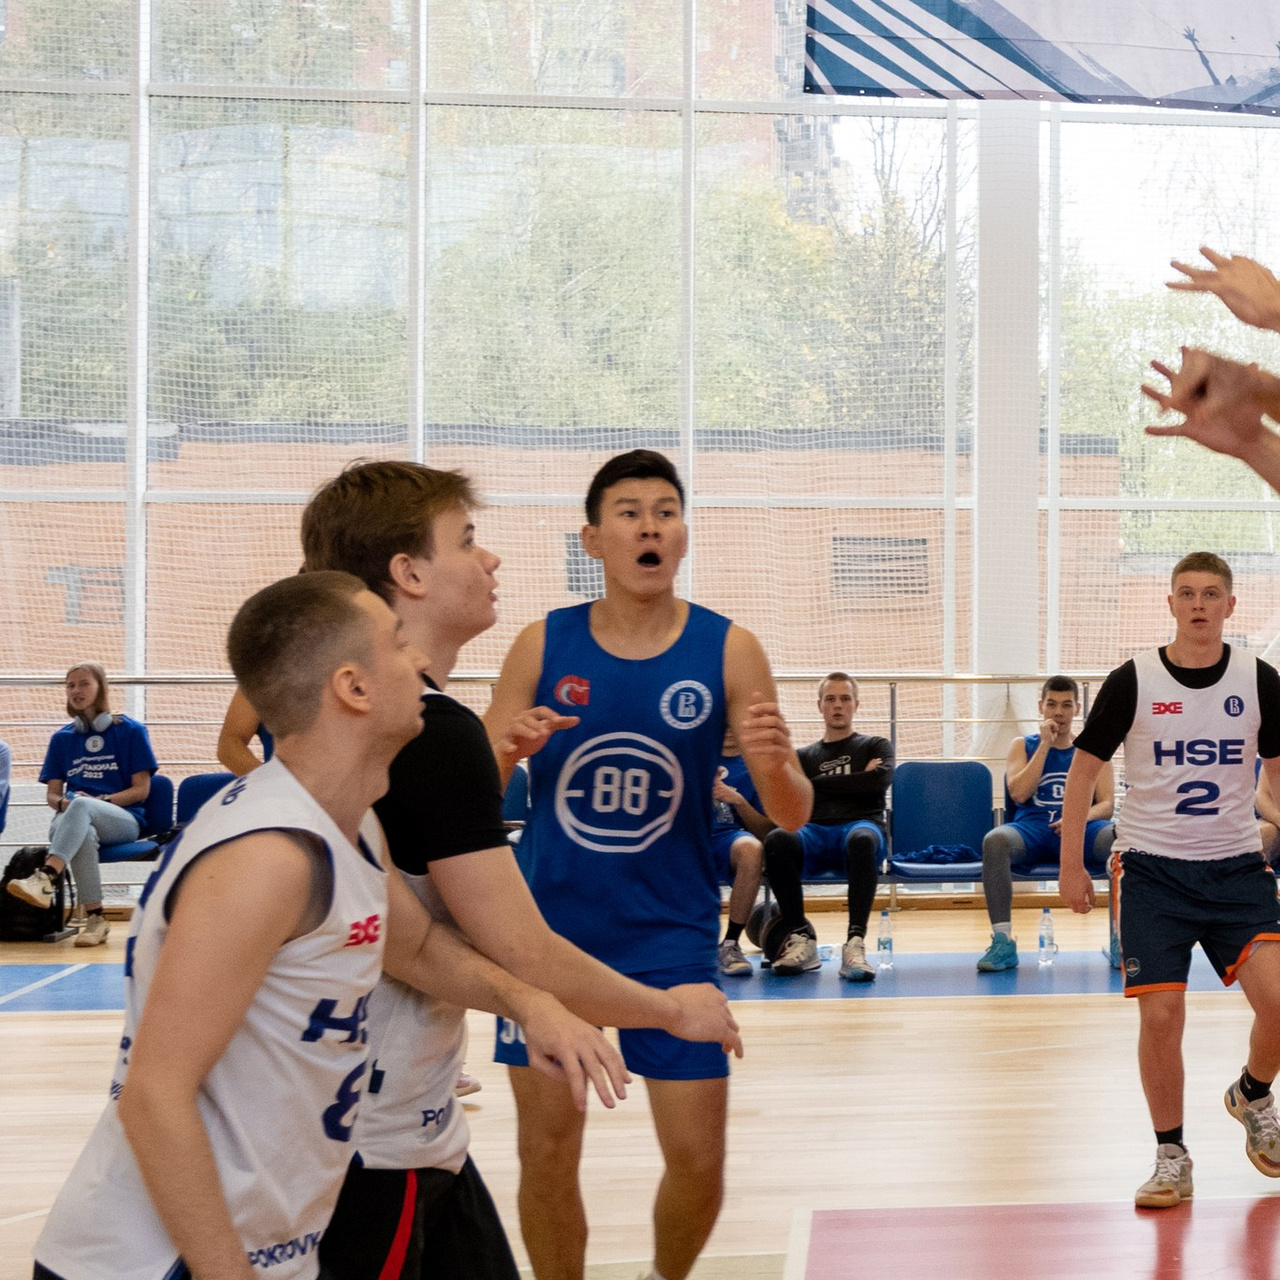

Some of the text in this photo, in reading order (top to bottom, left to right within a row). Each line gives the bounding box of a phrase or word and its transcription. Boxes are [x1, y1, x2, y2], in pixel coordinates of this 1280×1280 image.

[1153, 739, 1246, 767] HSE
[592, 766, 651, 816] 88
[1175, 780, 1221, 816] 2
